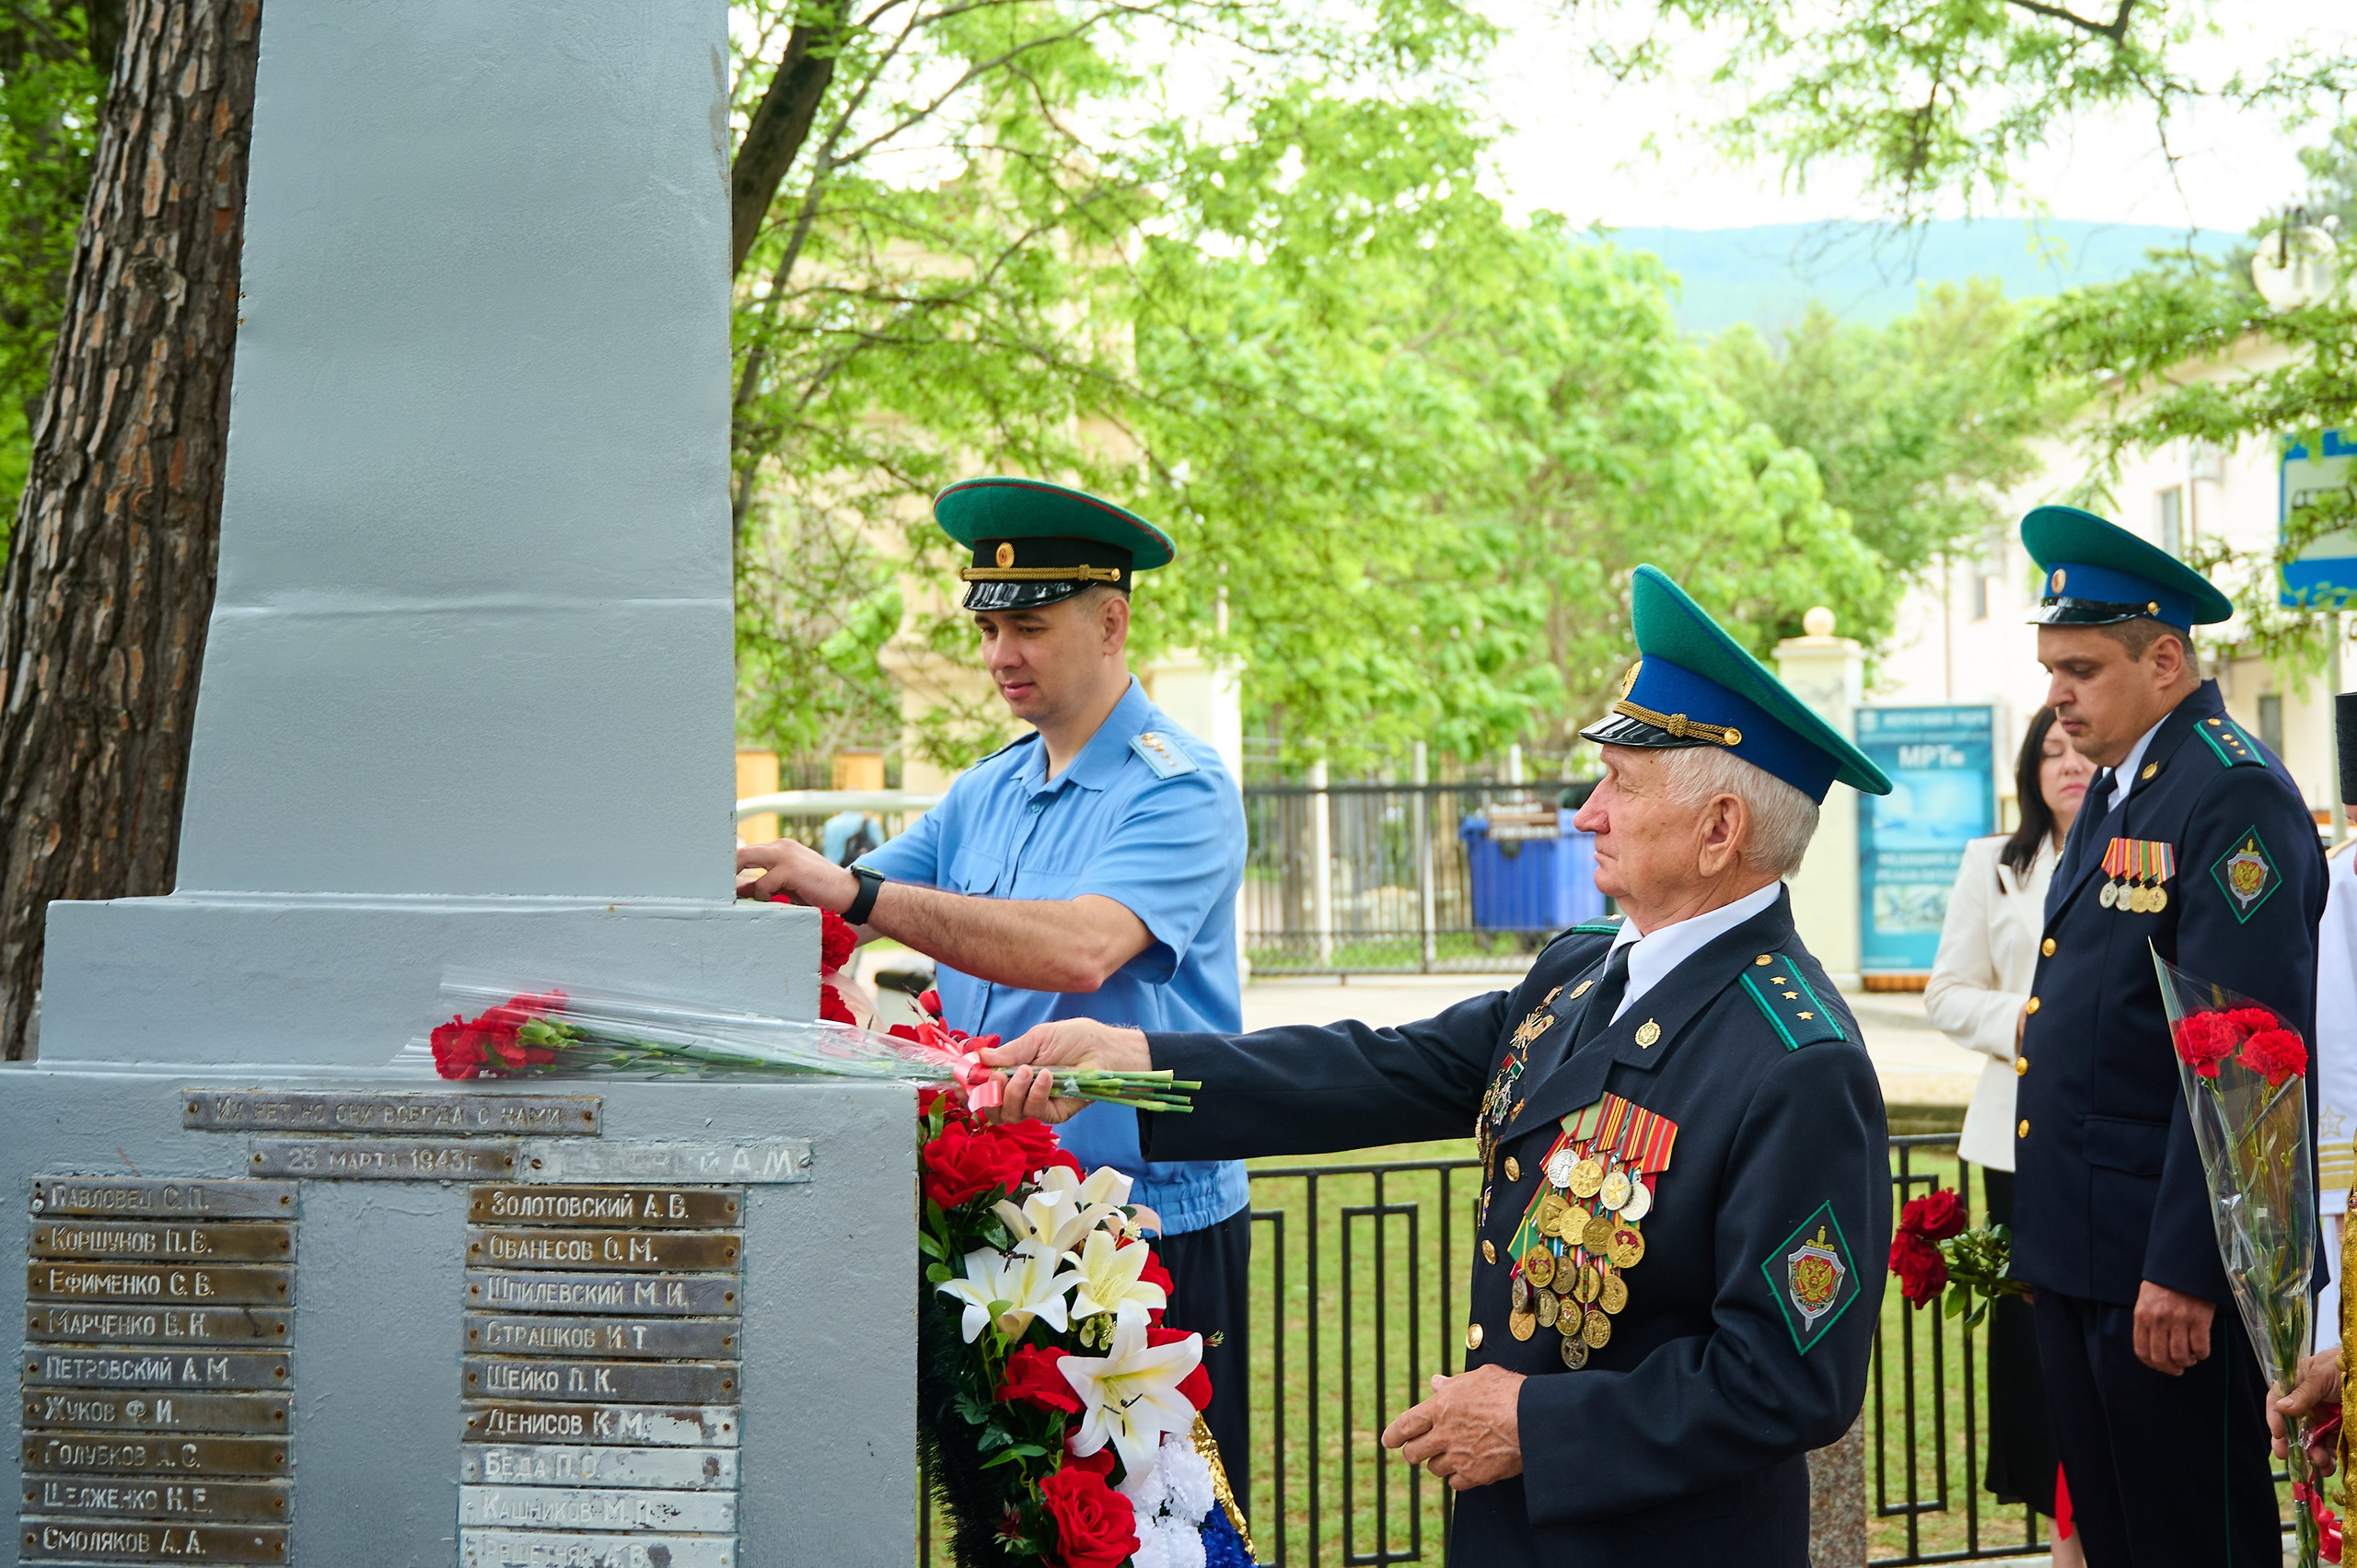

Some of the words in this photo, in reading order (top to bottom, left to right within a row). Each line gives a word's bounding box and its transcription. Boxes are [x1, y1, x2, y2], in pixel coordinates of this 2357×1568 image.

[336, 1104, 374, 1124] ОНИ
[384, 1105, 463, 1126] ВСЕГДА
[478, 1105, 491, 1125] С
[502, 1107, 563, 1126] НАМИ
[288, 1147, 319, 1171] 23
[330, 1151, 400, 1171] МАРТА
[51, 1183, 154, 1211] ПАВЛОВЕЦ
[491, 1191, 633, 1218] ЗОЛОТОВСКИЙ
[52, 1226, 157, 1253] КОРШУНОВ
[490, 1234, 594, 1261] ОВАНЕСОВ
[49, 1268, 160, 1295] ЕФИМЕНКО
[487, 1276, 624, 1306] ШПИЛЕВСКИЙ
[49, 1309, 156, 1336] МАРЧЕНКО
[487, 1320, 597, 1349] СТРАШКОВ
[46, 1355, 172, 1382] ПЕТРОВСКИЙ
[486, 1365, 559, 1392] ШЕЙКО
[45, 1396, 115, 1423] ЖУКОВ
[484, 1409, 583, 1436] ДЕНИСОВ
[45, 1439, 146, 1467] ГОЛУБКОВ
[484, 1451, 546, 1477] БЕДА
[482, 1492, 592, 1522] КАШНИКОВ
[43, 1526, 150, 1553] СМОЛЯКОВ
